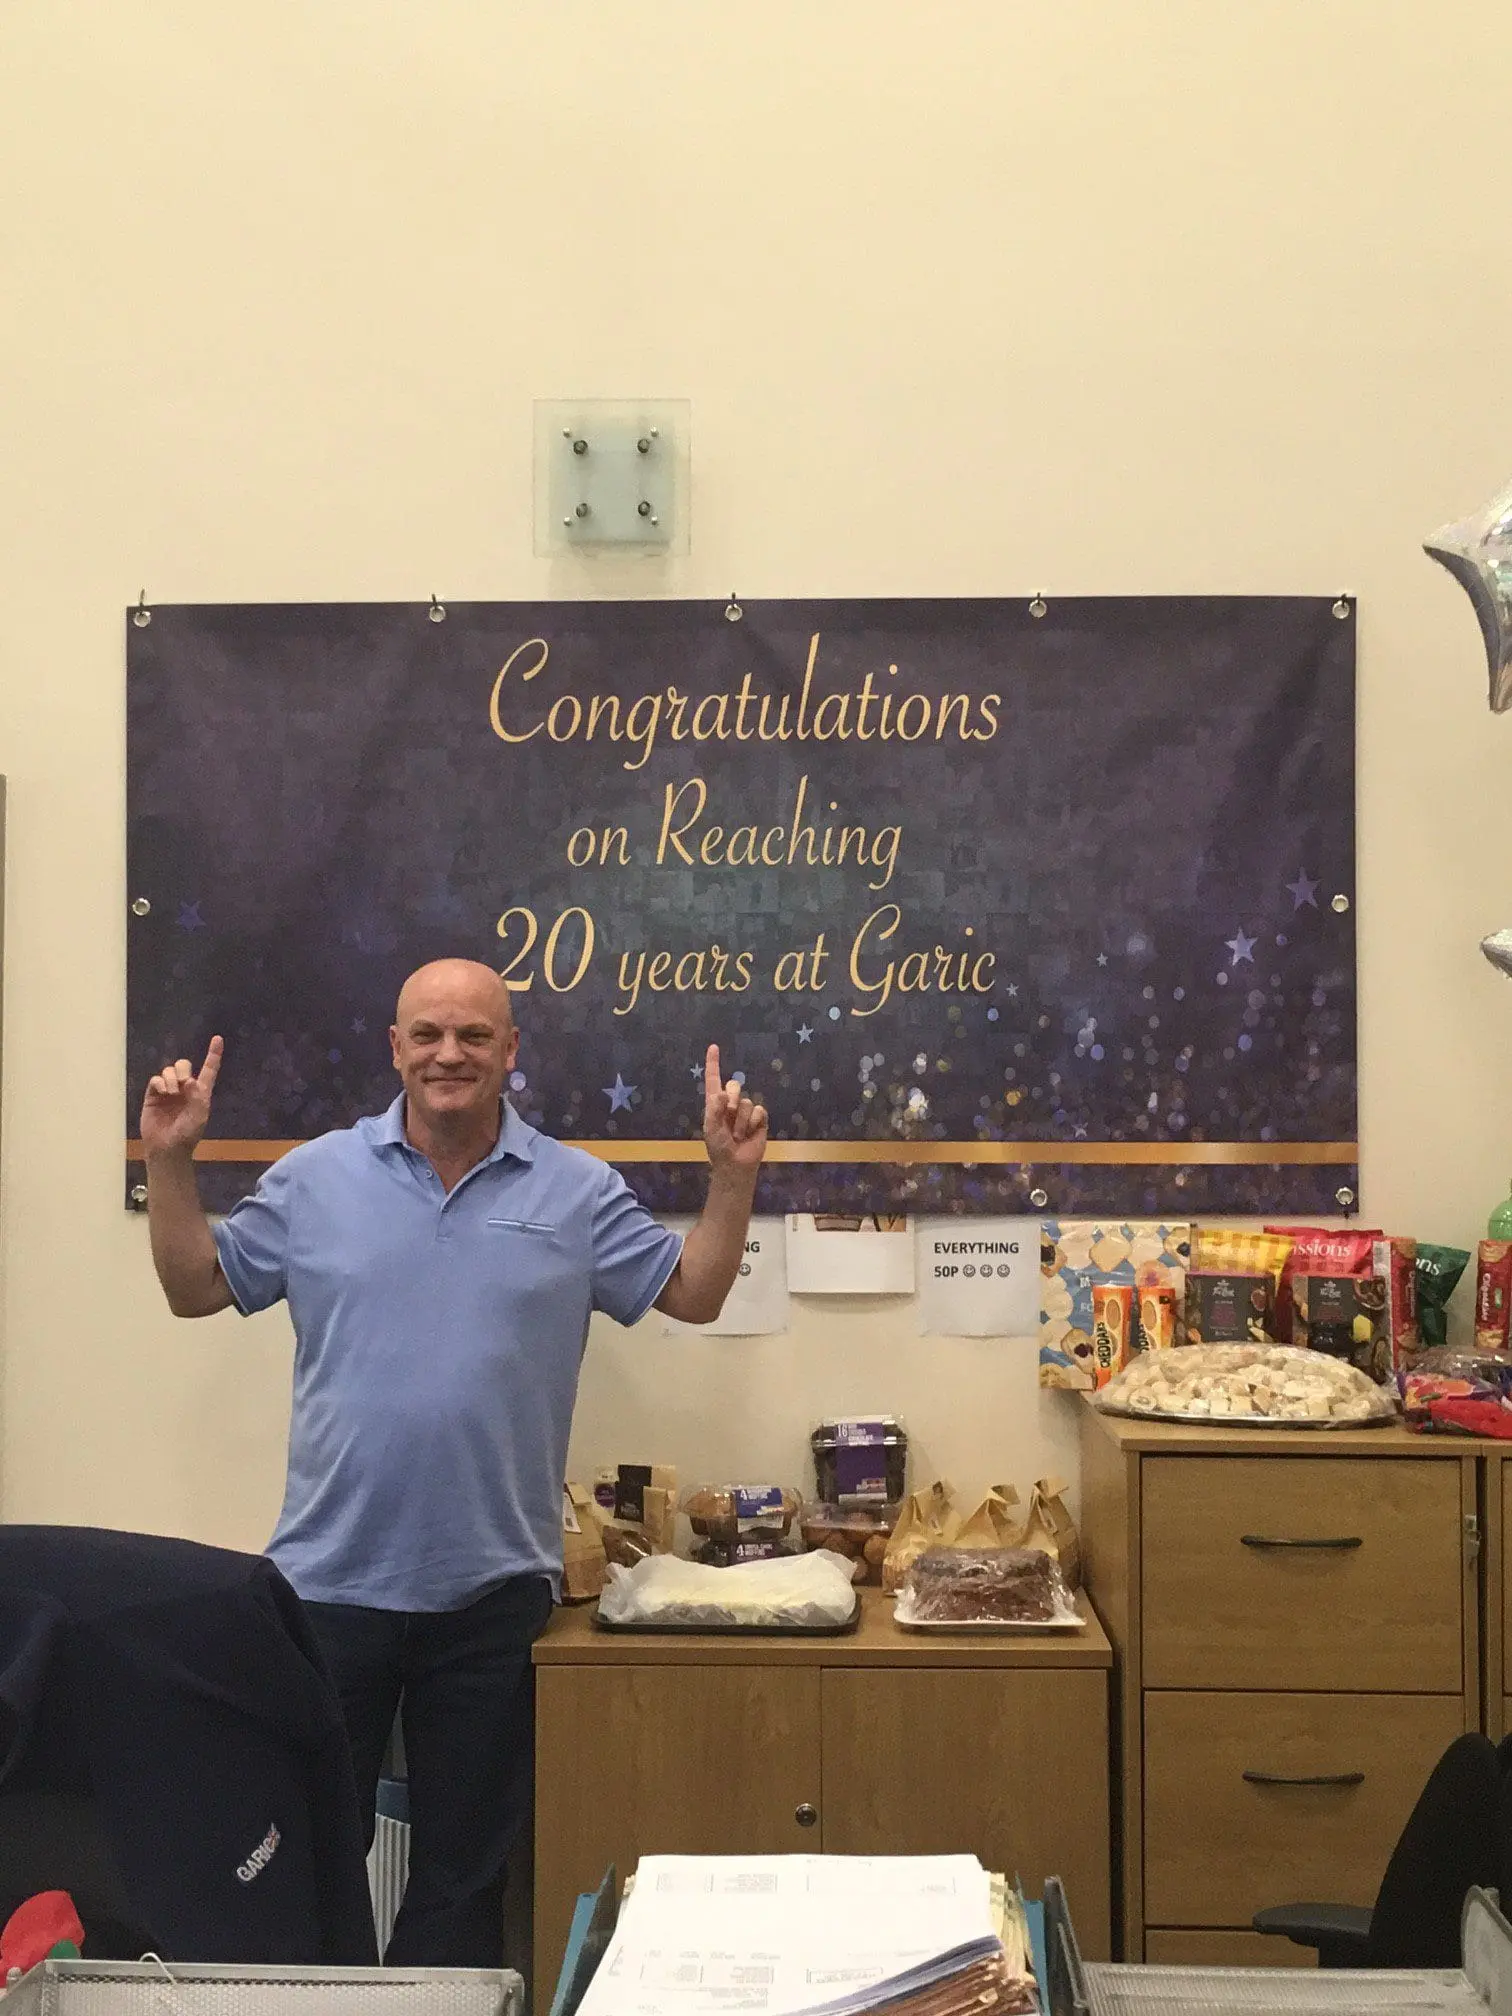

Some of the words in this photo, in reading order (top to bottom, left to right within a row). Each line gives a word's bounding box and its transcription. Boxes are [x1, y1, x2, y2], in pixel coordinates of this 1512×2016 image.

[489, 632, 1001, 770] Congratulations
[566, 825, 630, 867] on
[655, 775, 902, 890] Reaching
[496, 906, 596, 993] 20
[613, 945, 753, 1016] years
[773, 932, 829, 992] at
[849, 903, 996, 1017] Garic
[933, 1242, 1019, 1254] EVERYTHING
[933, 1265, 959, 1278] 50P
[236, 1837, 277, 1881] GARIC
